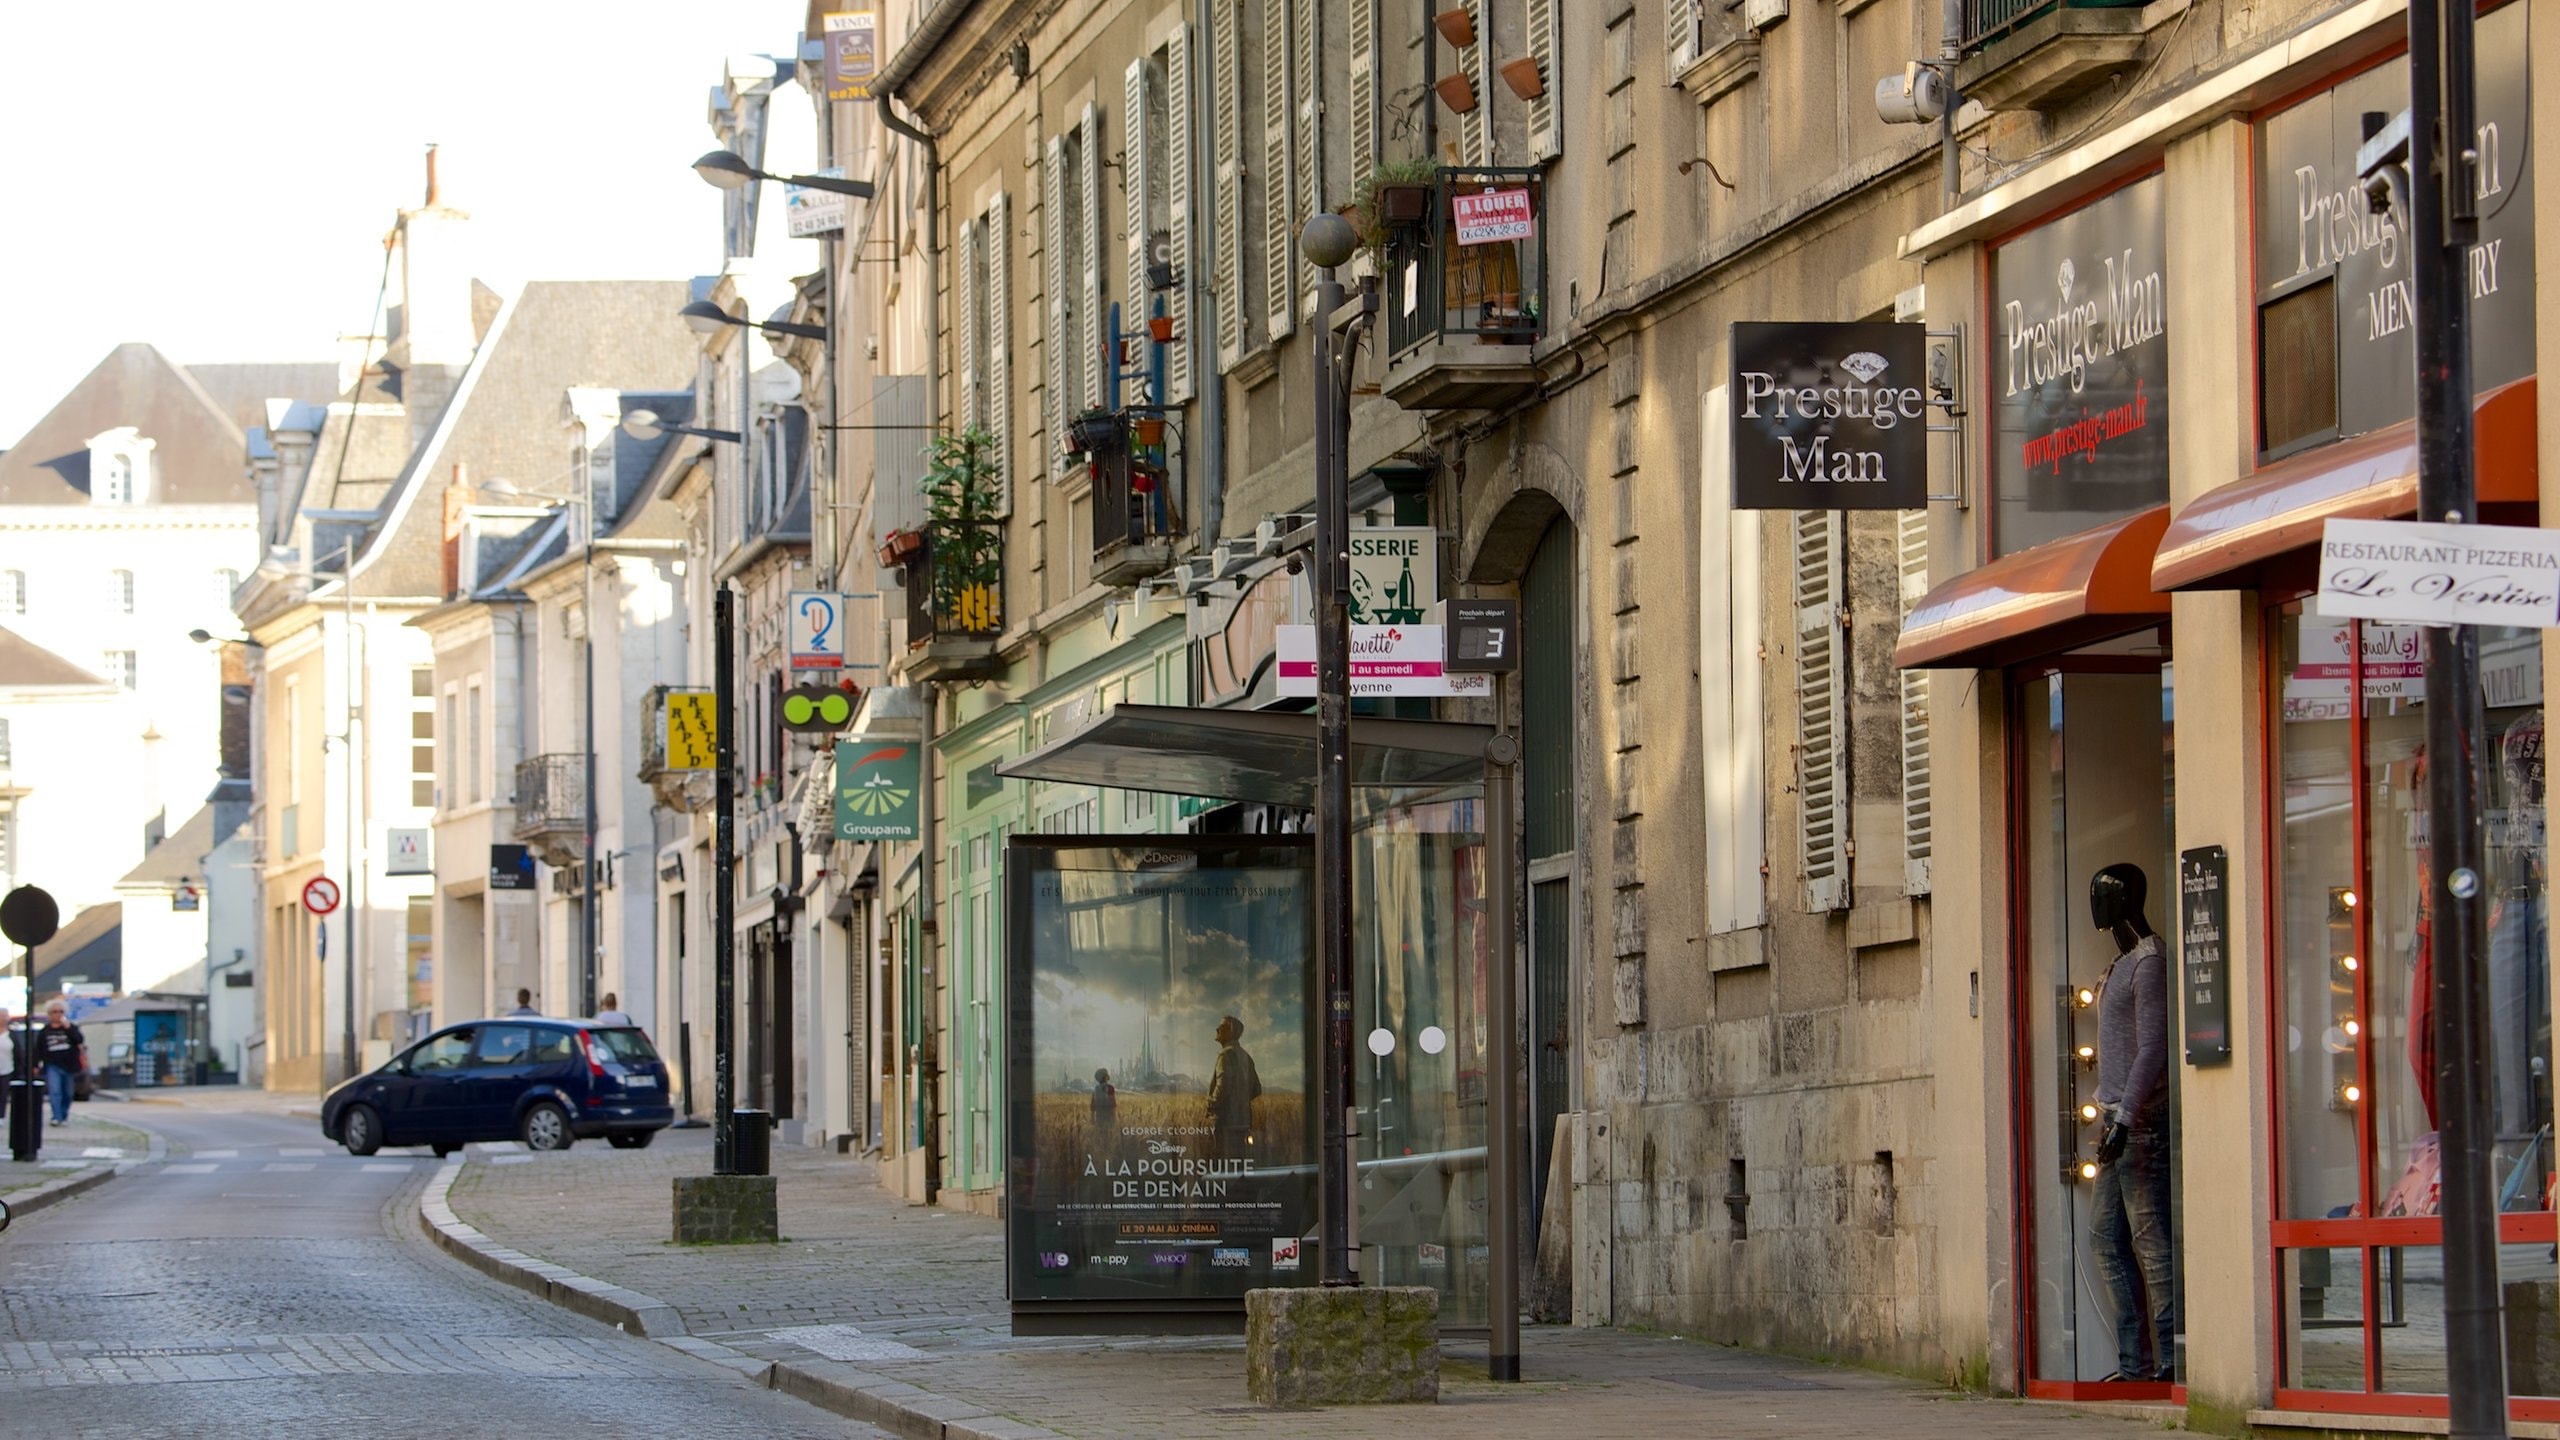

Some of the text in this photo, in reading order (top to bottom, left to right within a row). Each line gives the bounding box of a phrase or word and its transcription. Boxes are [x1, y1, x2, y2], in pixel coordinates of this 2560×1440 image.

[1460, 195, 1525, 214] A LOUER
[2006, 248, 2163, 397] Prestige Man
[1740, 371, 1923, 430] Prestige
[2022, 378, 2149, 476] www.prestige-man.fr
[1778, 436, 1888, 483] Man
[1350, 539, 1419, 557] SSERIE
[2325, 542, 2559, 569] RESTAURANT PIZZERIA
[2324, 567, 2553, 607] Le Venise
[1459, 609, 1506, 619] Prochain départ
[1350, 630, 1394, 655] avette
[1485, 627, 1505, 658] 3
[1358, 665, 1371, 674] au
[1374, 664, 1413, 675] samedi
[843, 822, 912, 837] Groupama
[1190, 888, 1211, 897] TOUT
[1242, 888, 1282, 897] POSSIBLE
[1122, 1126, 1216, 1136] GEORGE CLOONEY
[1146, 1140, 1187, 1157] Disney
[1084, 1154, 1255, 1176] À LA POURSUITE
[1112, 1180, 1227, 1197] DE DEMAIN
[1122, 1223, 1216, 1233] LE 20 MAI AU CINÉMA
[1040, 1252, 1069, 1268] W9
[1154, 1253, 1188, 1264] YAHOO!
[1211, 1258, 1251, 1267] MAGAZINE
